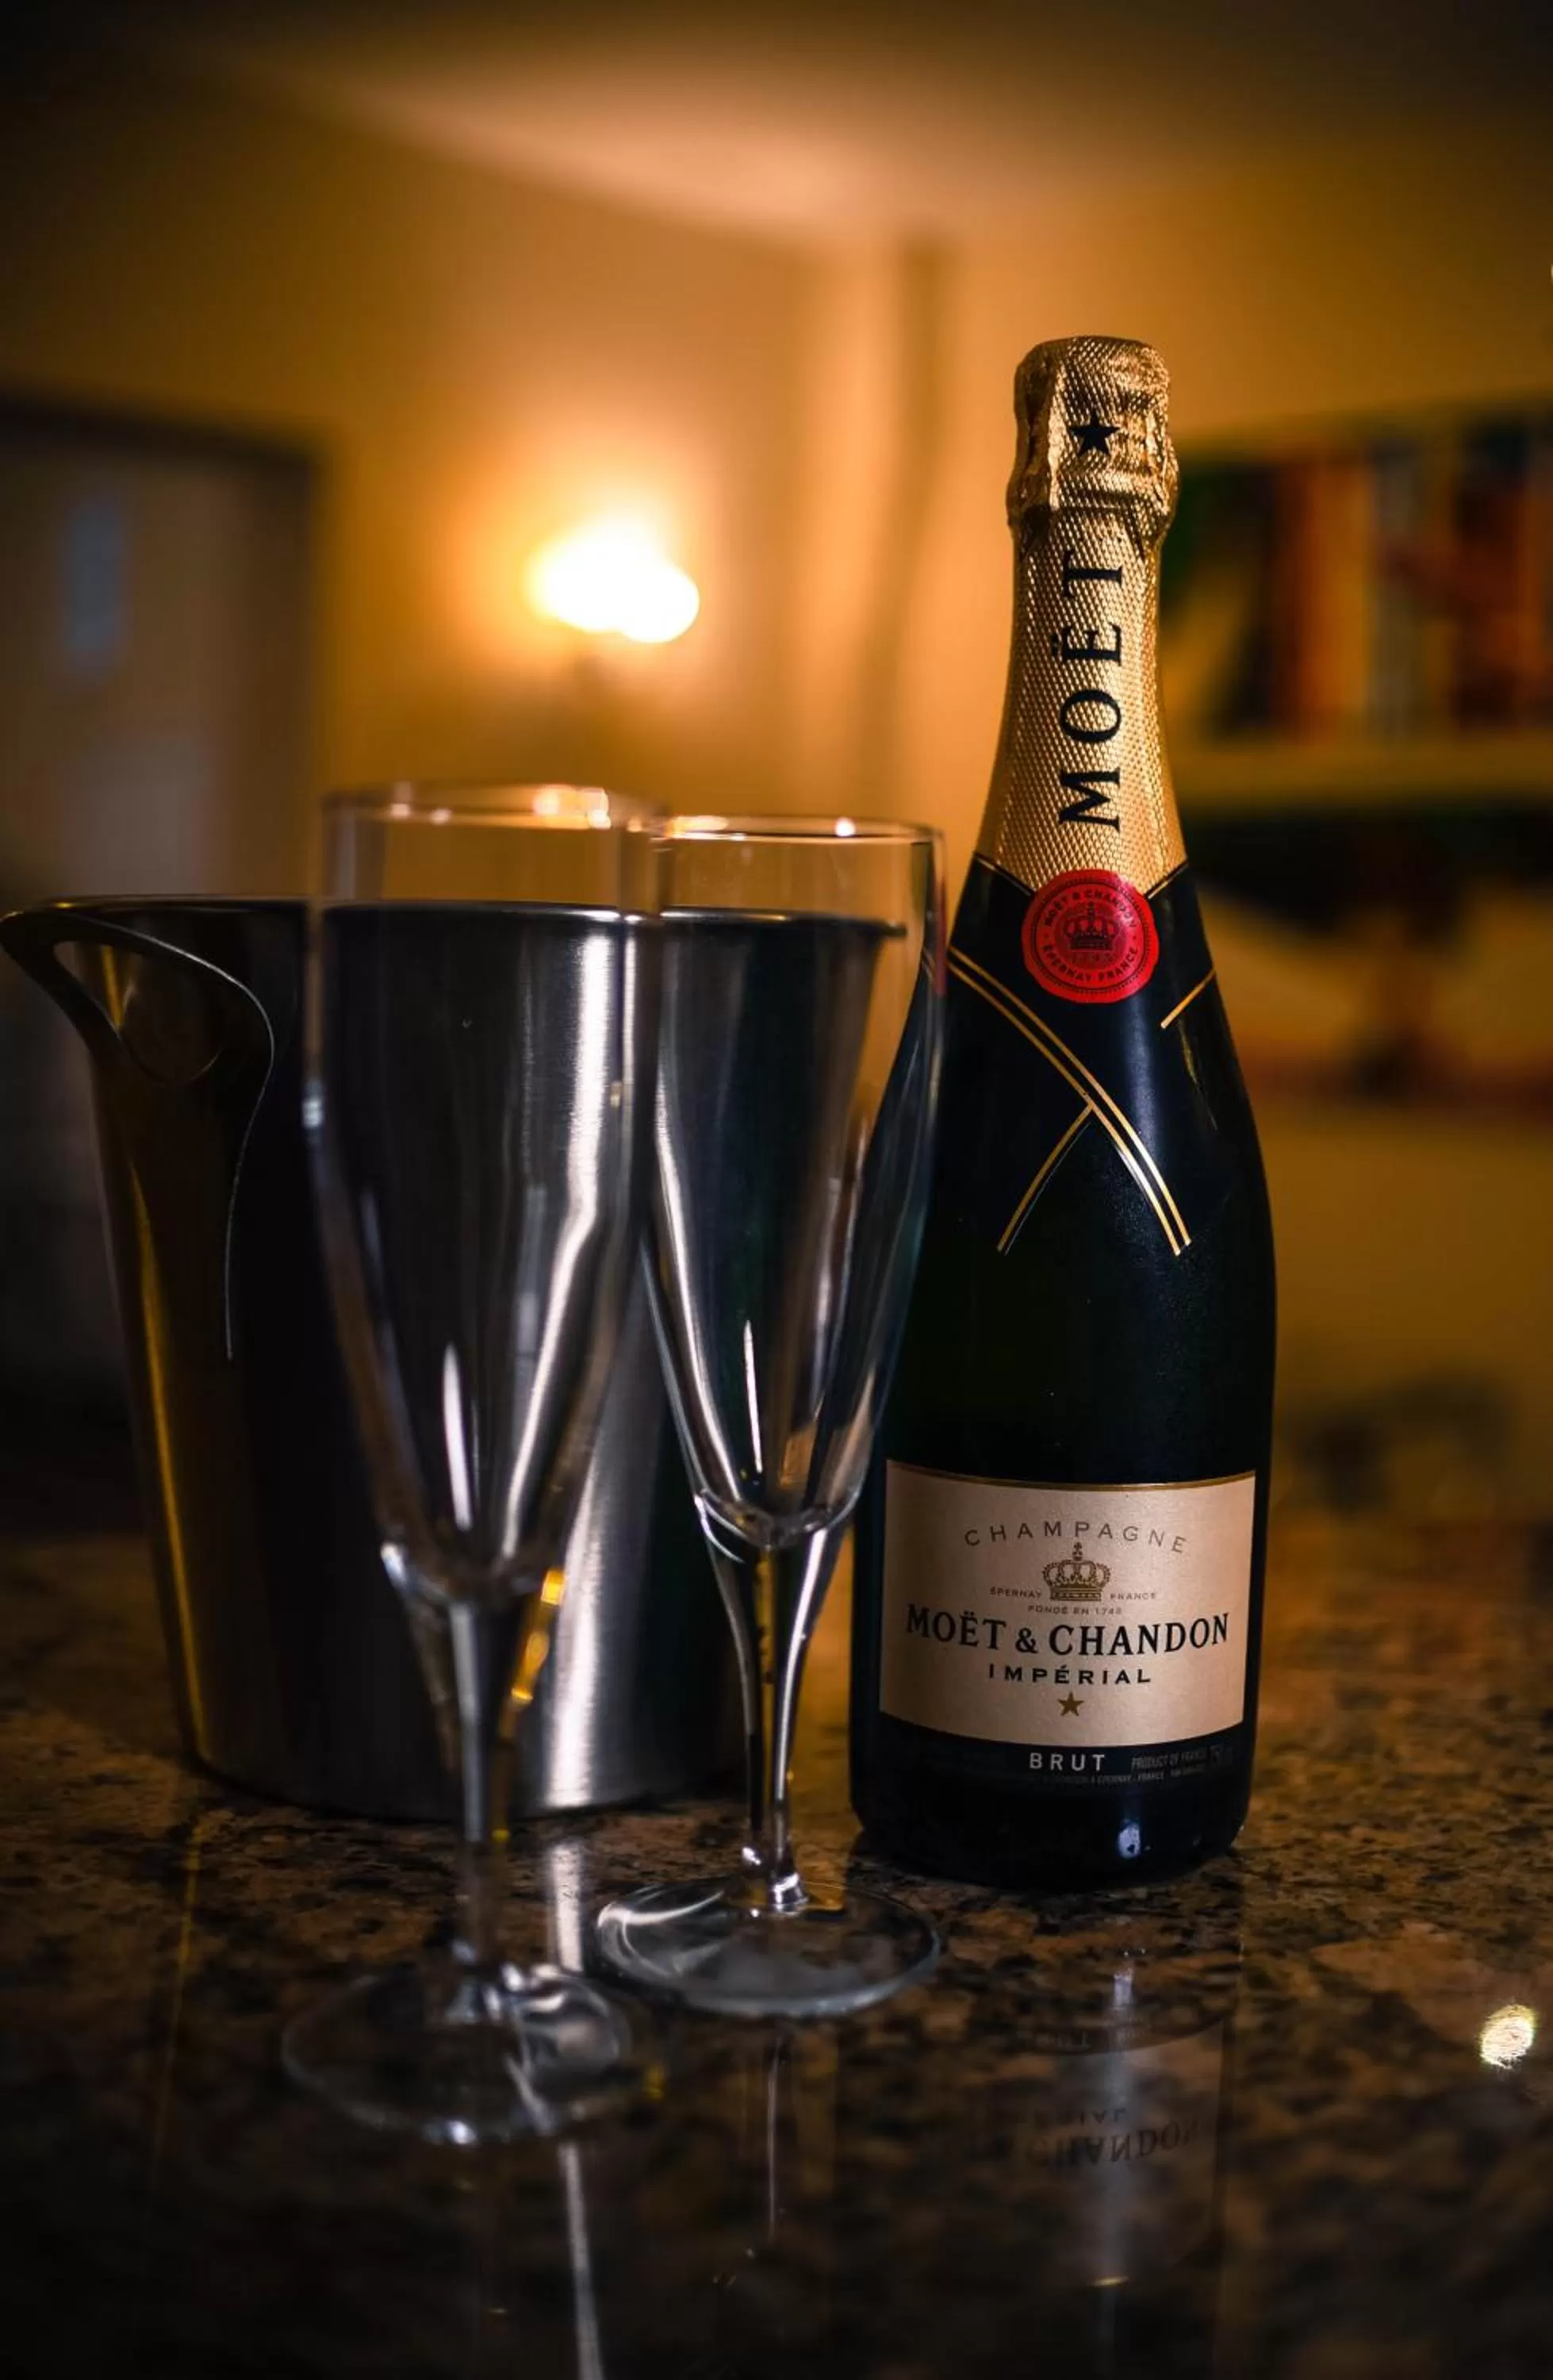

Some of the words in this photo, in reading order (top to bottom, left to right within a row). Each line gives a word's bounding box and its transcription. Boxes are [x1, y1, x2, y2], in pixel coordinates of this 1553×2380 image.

[1052, 549, 1122, 833] MOËT
[1098, 947, 1137, 981] FRANCE
[964, 1520, 1187, 1554] CHAMPAGNE
[1072, 1606, 1090, 1615] EN
[907, 1603, 1007, 1651] MOËT
[1014, 1626, 1039, 1654] &
[1049, 1611, 1230, 1656] CHANDON
[988, 1663, 1152, 1685] IMPÉRIAL
[1029, 1752, 1106, 1772] BRUT
[1131, 1753, 1168, 1770] PRODUCT
